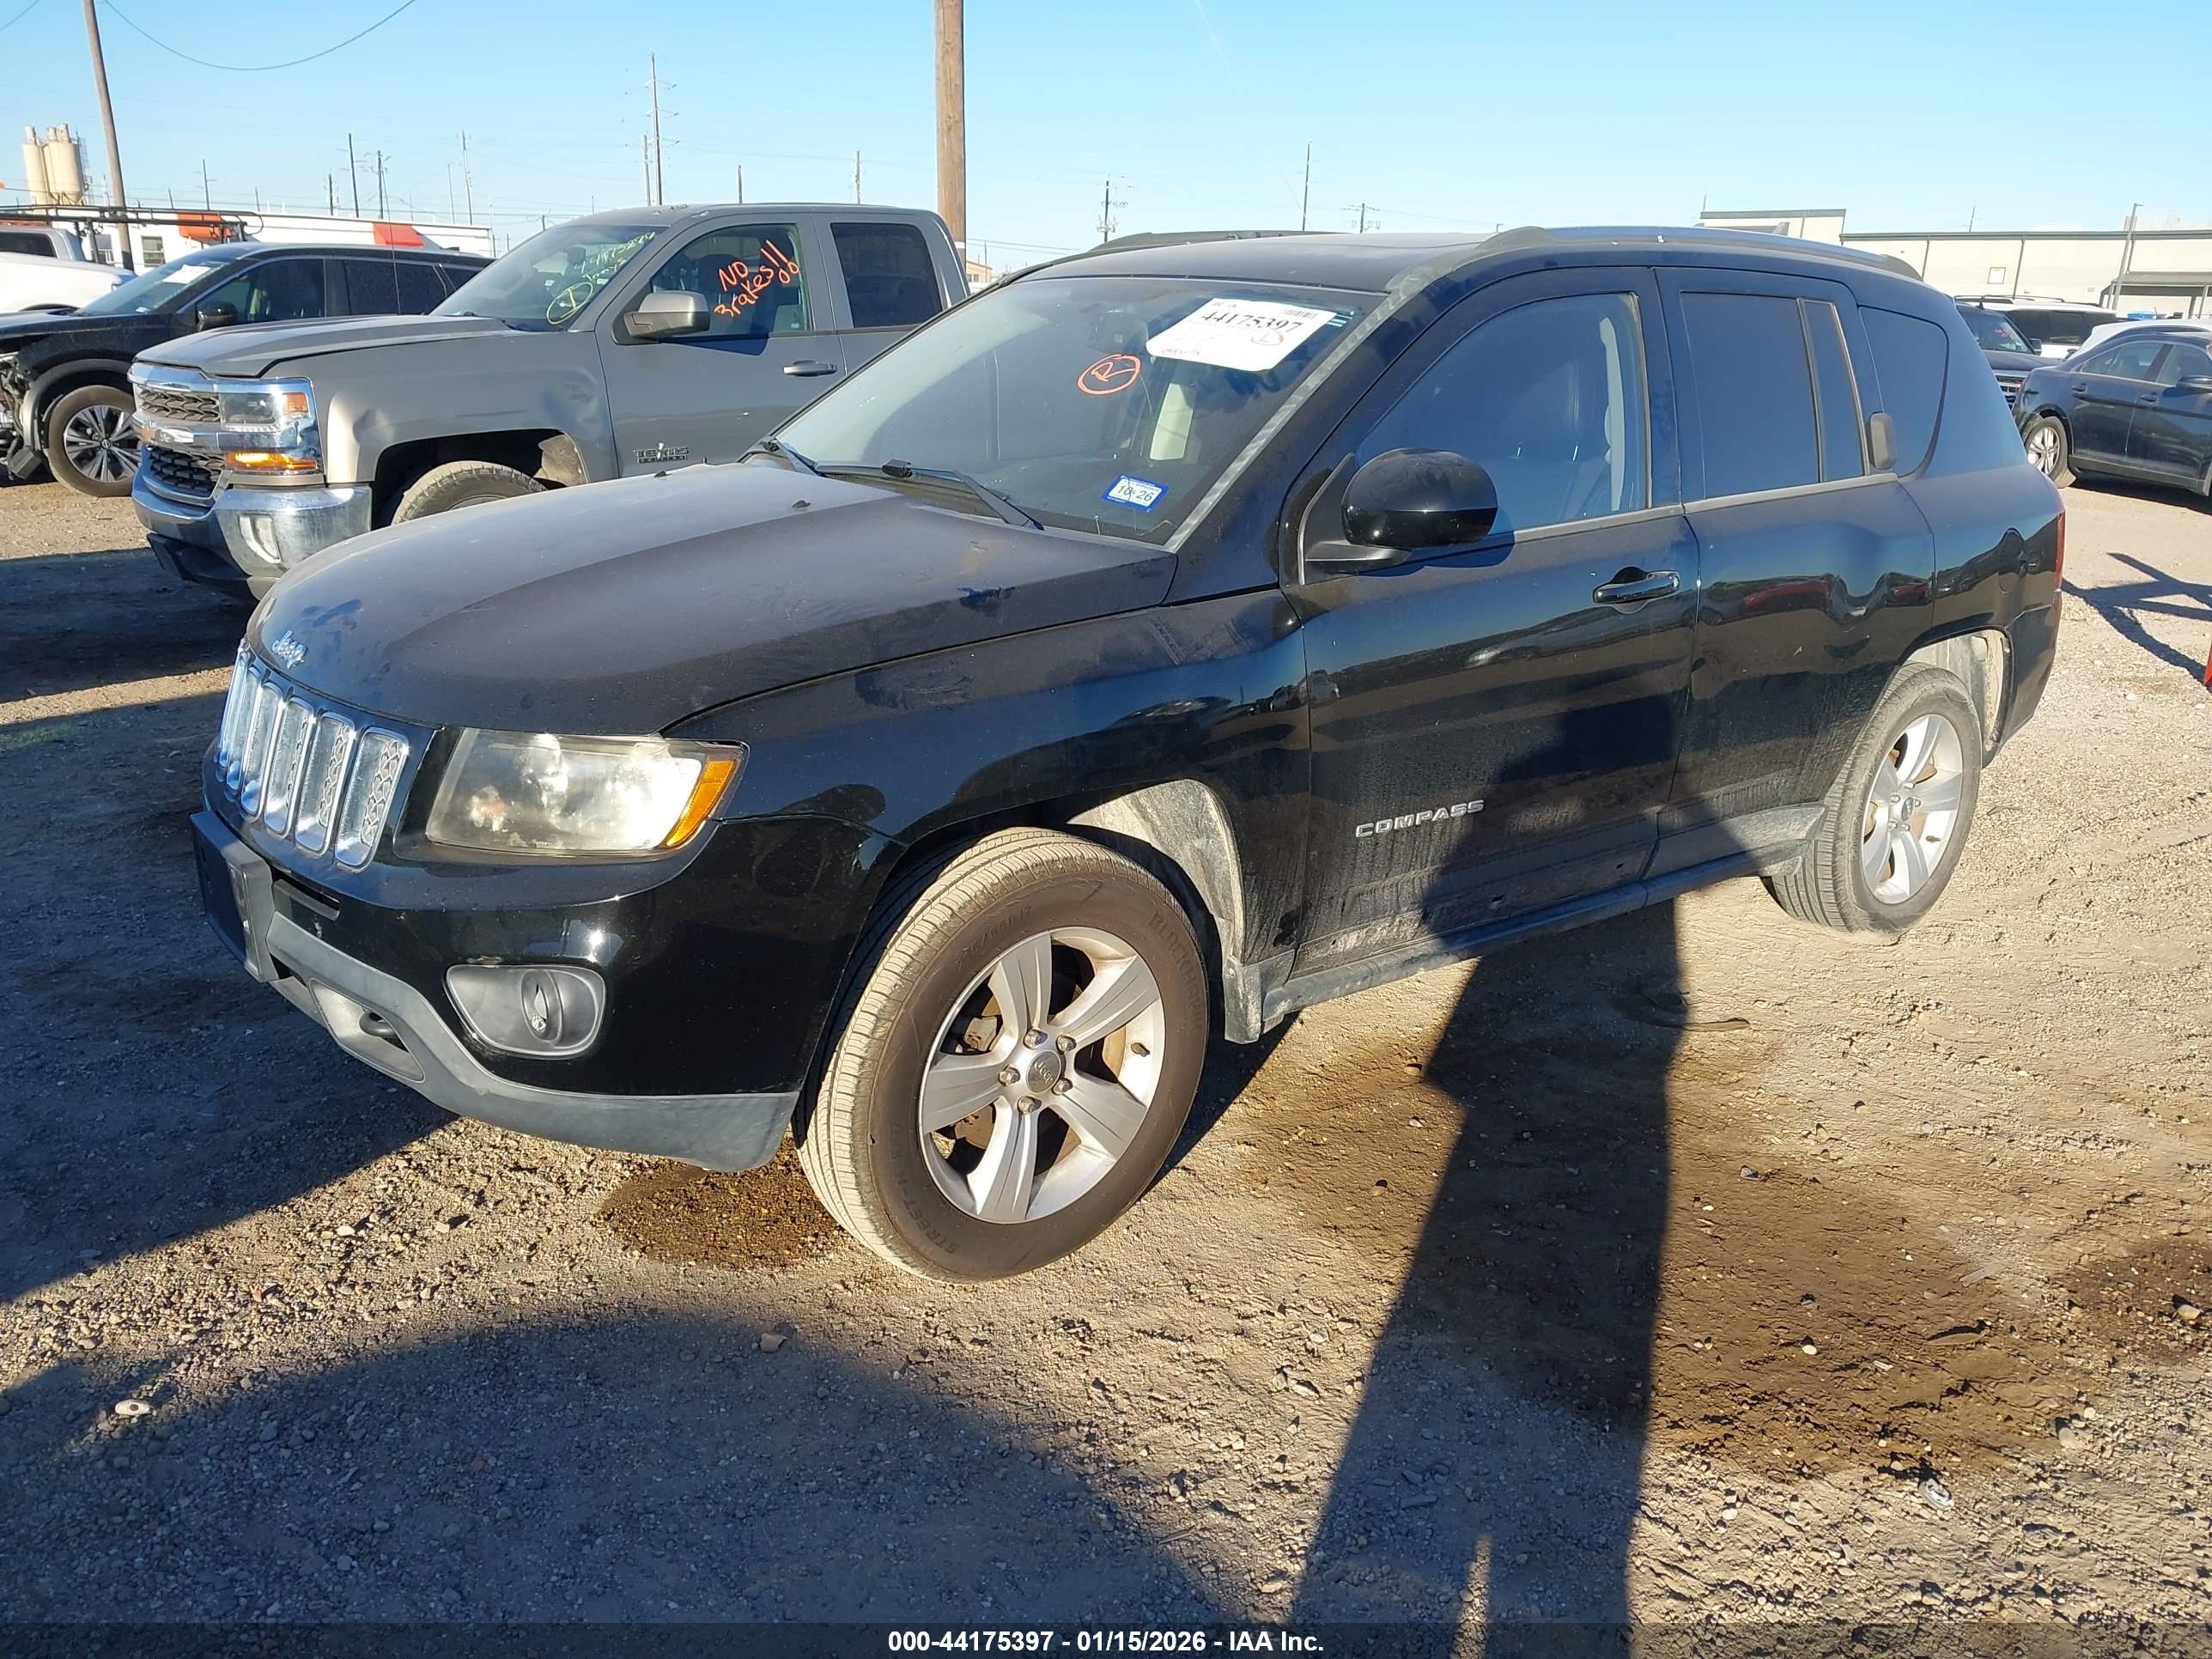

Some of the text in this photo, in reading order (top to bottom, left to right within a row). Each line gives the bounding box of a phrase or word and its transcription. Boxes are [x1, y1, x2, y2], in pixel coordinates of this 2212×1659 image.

[719, 261, 748, 292] NO
[1201, 310, 1305, 333] 44175397
[1356, 799, 1485, 838] COMPASS
[893, 1170, 961, 1255] STREET-H
